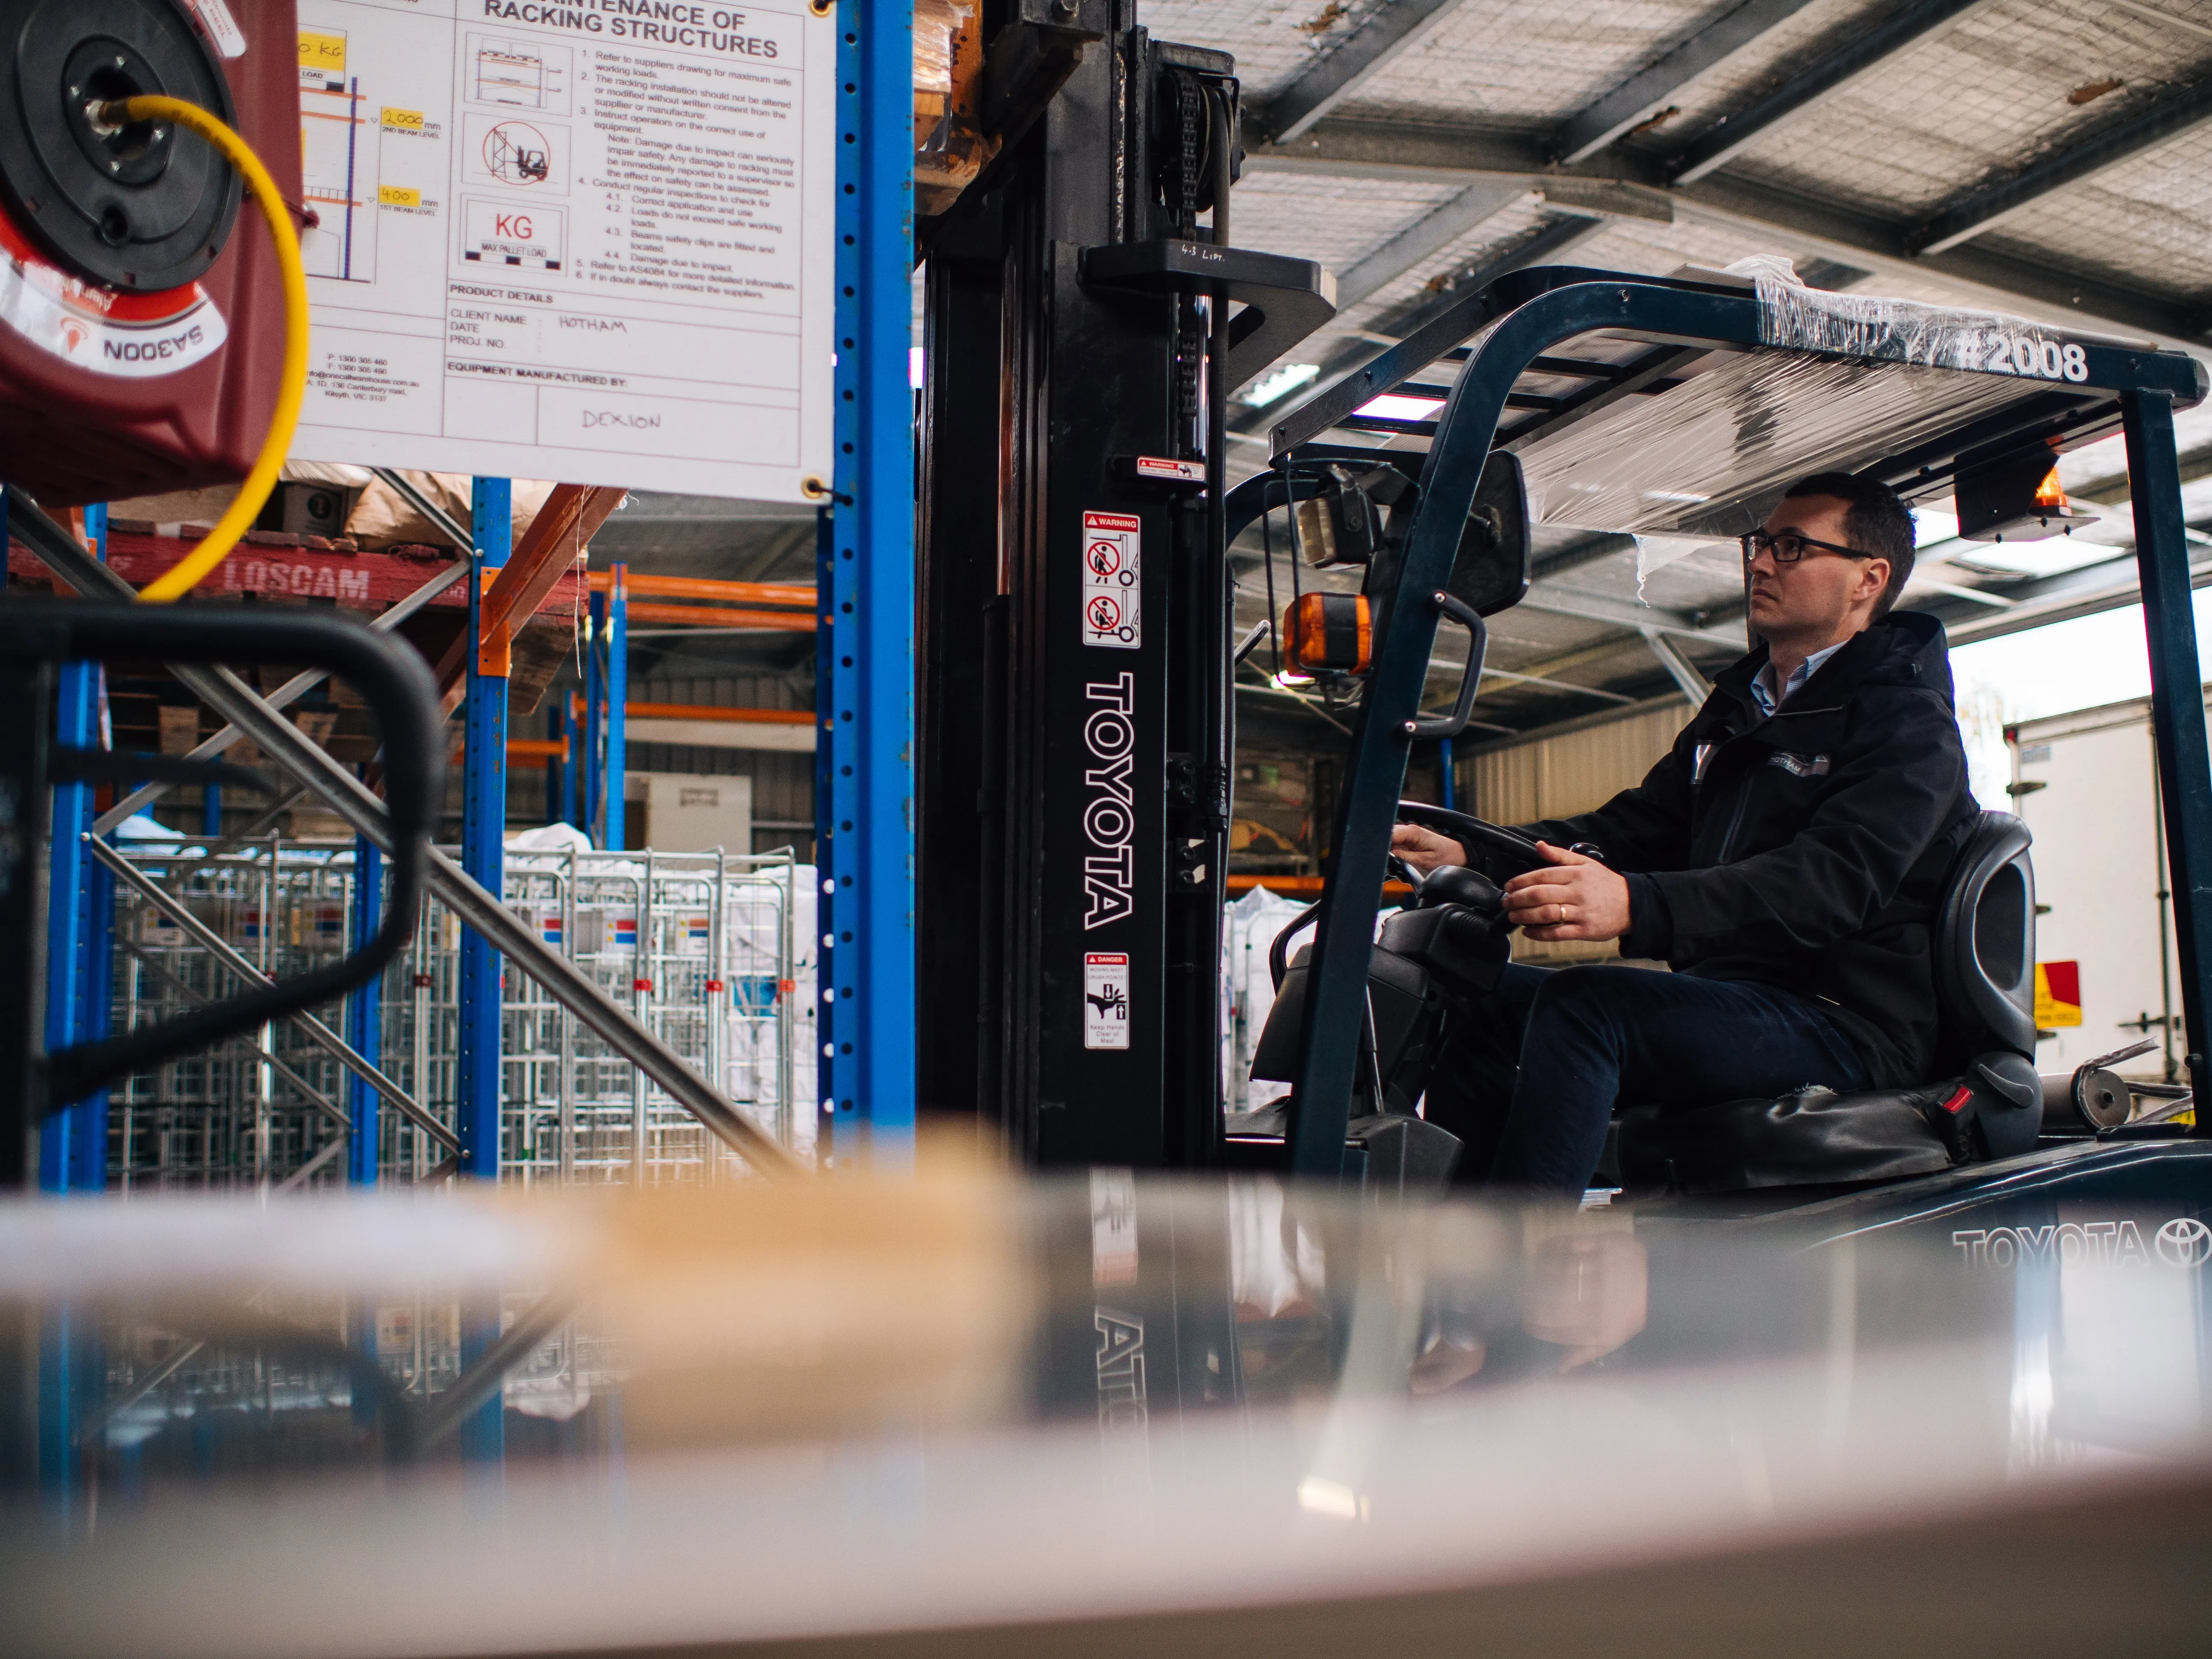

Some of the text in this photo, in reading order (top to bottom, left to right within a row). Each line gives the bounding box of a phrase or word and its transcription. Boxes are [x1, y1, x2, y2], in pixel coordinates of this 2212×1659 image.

[485, 0, 778, 58] RACKING STRUCTURES
[713, 11, 746, 31] OF
[595, 64, 659, 79] working loads.
[596, 51, 620, 61] Refer
[634, 58, 675, 70] suppliers
[676, 64, 712, 77] drawing
[713, 68, 727, 77] for
[728, 72, 771, 83] maximum
[773, 78, 792, 87] safe
[595, 74, 613, 84] The
[615, 79, 648, 90] racking
[650, 82, 698, 96] installation
[700, 90, 729, 100] should
[748, 96, 759, 104] be
[761, 98, 792, 109] altered
[607, 89, 645, 100] modified
[647, 94, 679, 105] without
[681, 99, 711, 109] written
[713, 104, 748, 114] consent
[750, 107, 770, 117] from
[772, 111, 786, 119] the
[424, 122, 441, 131] mm
[594, 109, 628, 120] Instruct
[630, 115, 673, 127] operators
[689, 122, 703, 131] the
[705, 125, 736, 135] correct
[594, 122, 643, 134] equipment.
[398, 128, 417, 137] BEAM
[419, 131, 440, 139] LEVEL
[607, 146, 636, 156] impair
[637, 151, 666, 162] safety.
[669, 154, 687, 164] Any
[689, 156, 725, 169] damage
[738, 164, 770, 175] racking
[772, 168, 793, 177] must
[608, 134, 632, 144] Note:
[634, 137, 673, 151] Damage
[675, 143, 693, 152] due
[694, 146, 703, 154] to
[705, 147, 735, 157] impact
[756, 155, 795, 167] seriously
[606, 169, 621, 178] the
[623, 171, 649, 181] effect
[665, 177, 692, 188] safety
[713, 182, 724, 191] be
[727, 185, 770, 196] assessed.
[607, 157, 619, 166] be
[621, 159, 675, 175] immediately
[678, 168, 715, 178] reported
[717, 172, 726, 180] to
[736, 175, 782, 186] supervisor
[381, 188, 410, 201] 400
[394, 206, 413, 214] BEAM
[415, 208, 436, 216] LEVEL
[496, 213, 533, 239] KG
[481, 243, 547, 257] MAX PALLET LOAD
[449, 285, 553, 303] PRODUCT DETAILS
[450, 309, 492, 321] CLIENT
[493, 313, 527, 325] NAME
[450, 322, 480, 333] DATE
[449, 335, 506, 349] PROJ. NO.
[446, 362, 628, 387] EQUIPMENT MANUFACTURED BY:
[582, 410, 661, 428] DEXION
[1098, 518, 1137, 529] WARNING
[224, 558, 370, 599] LOSCAM
[1084, 672, 1134, 930] TOYOTA
[1953, 1220, 2151, 1270] TOYOTA
